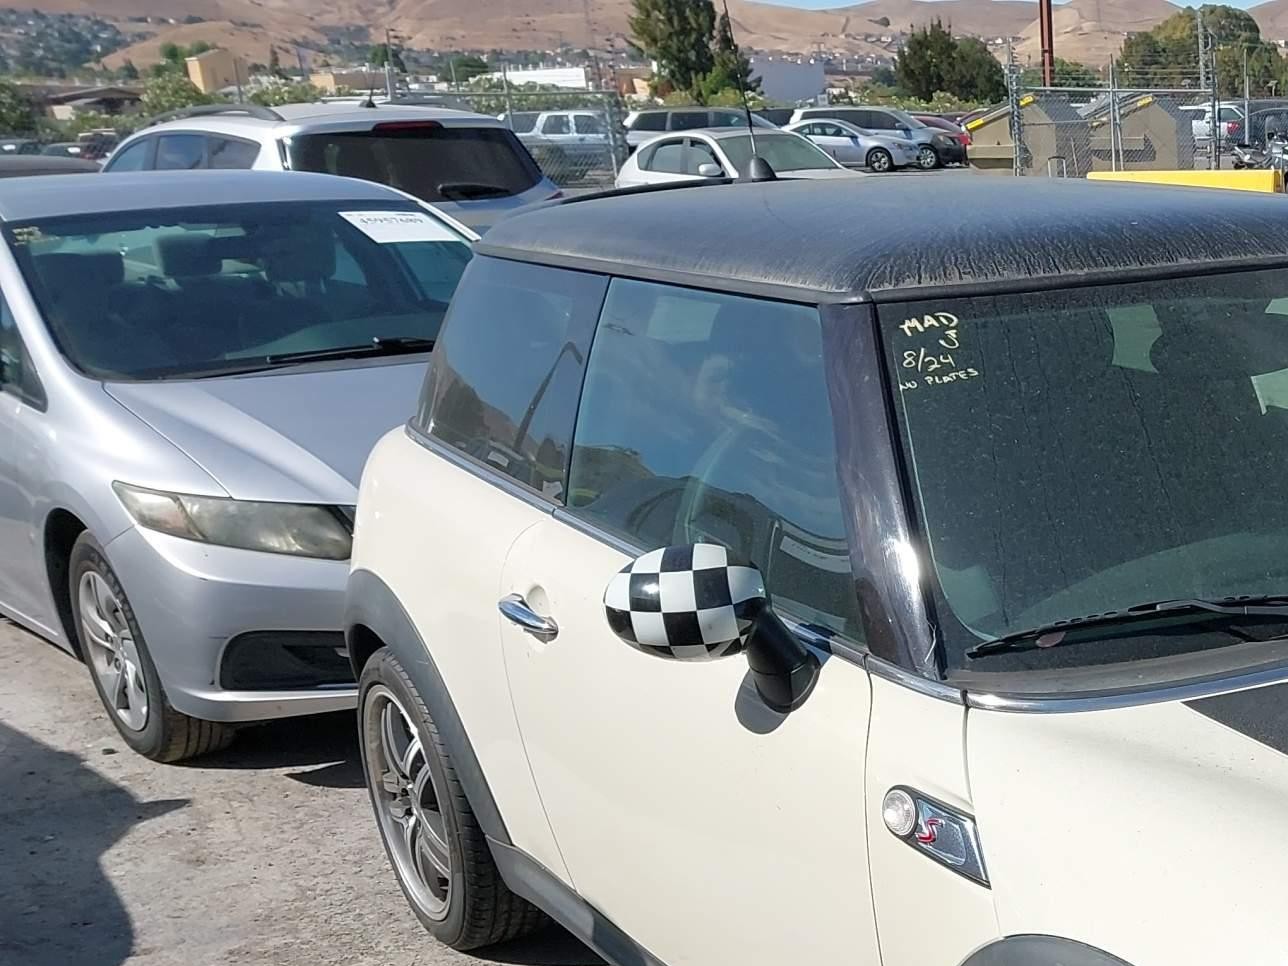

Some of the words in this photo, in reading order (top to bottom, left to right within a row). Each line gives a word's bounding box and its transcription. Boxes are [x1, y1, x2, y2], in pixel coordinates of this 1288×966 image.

[899, 312, 959, 337] MAD
[902, 347, 956, 372] 8/24
[924, 368, 979, 385] PLATES
